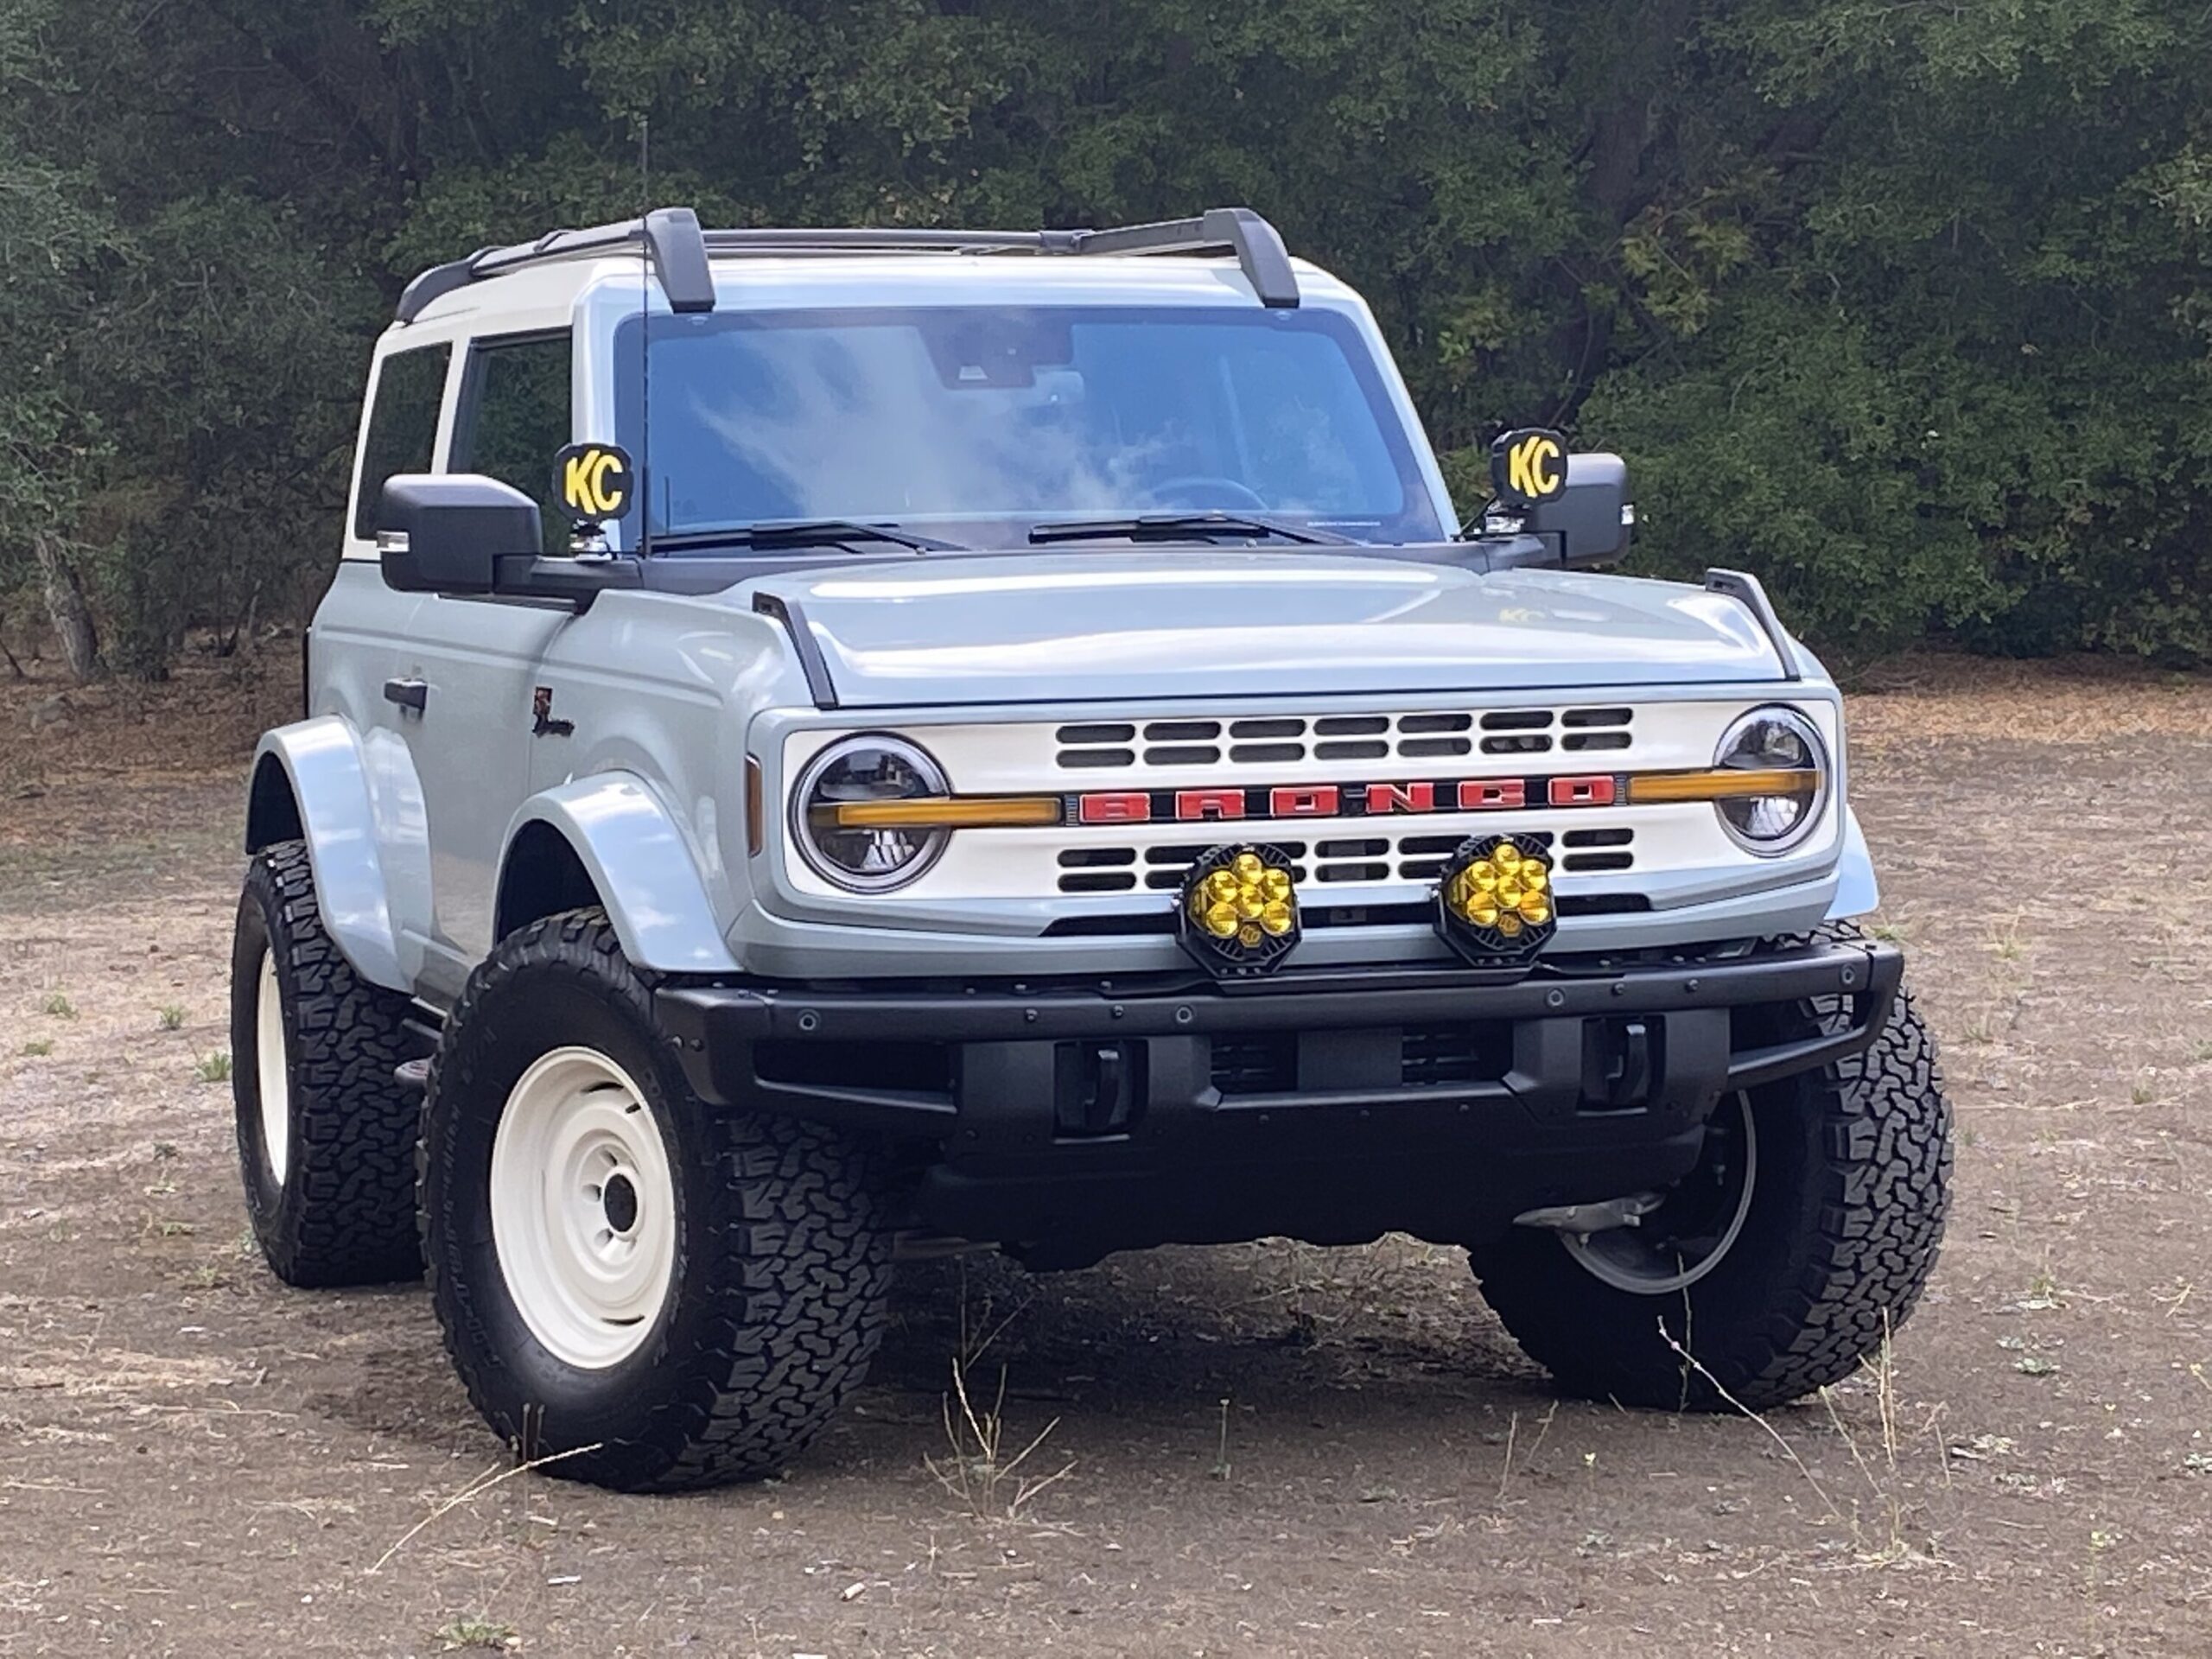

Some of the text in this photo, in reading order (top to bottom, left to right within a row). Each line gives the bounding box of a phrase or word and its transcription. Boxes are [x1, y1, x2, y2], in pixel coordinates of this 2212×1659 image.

[565, 449, 623, 515] KC
[1510, 435, 1560, 499] KC
[1079, 775, 1615, 823] BRONCO
